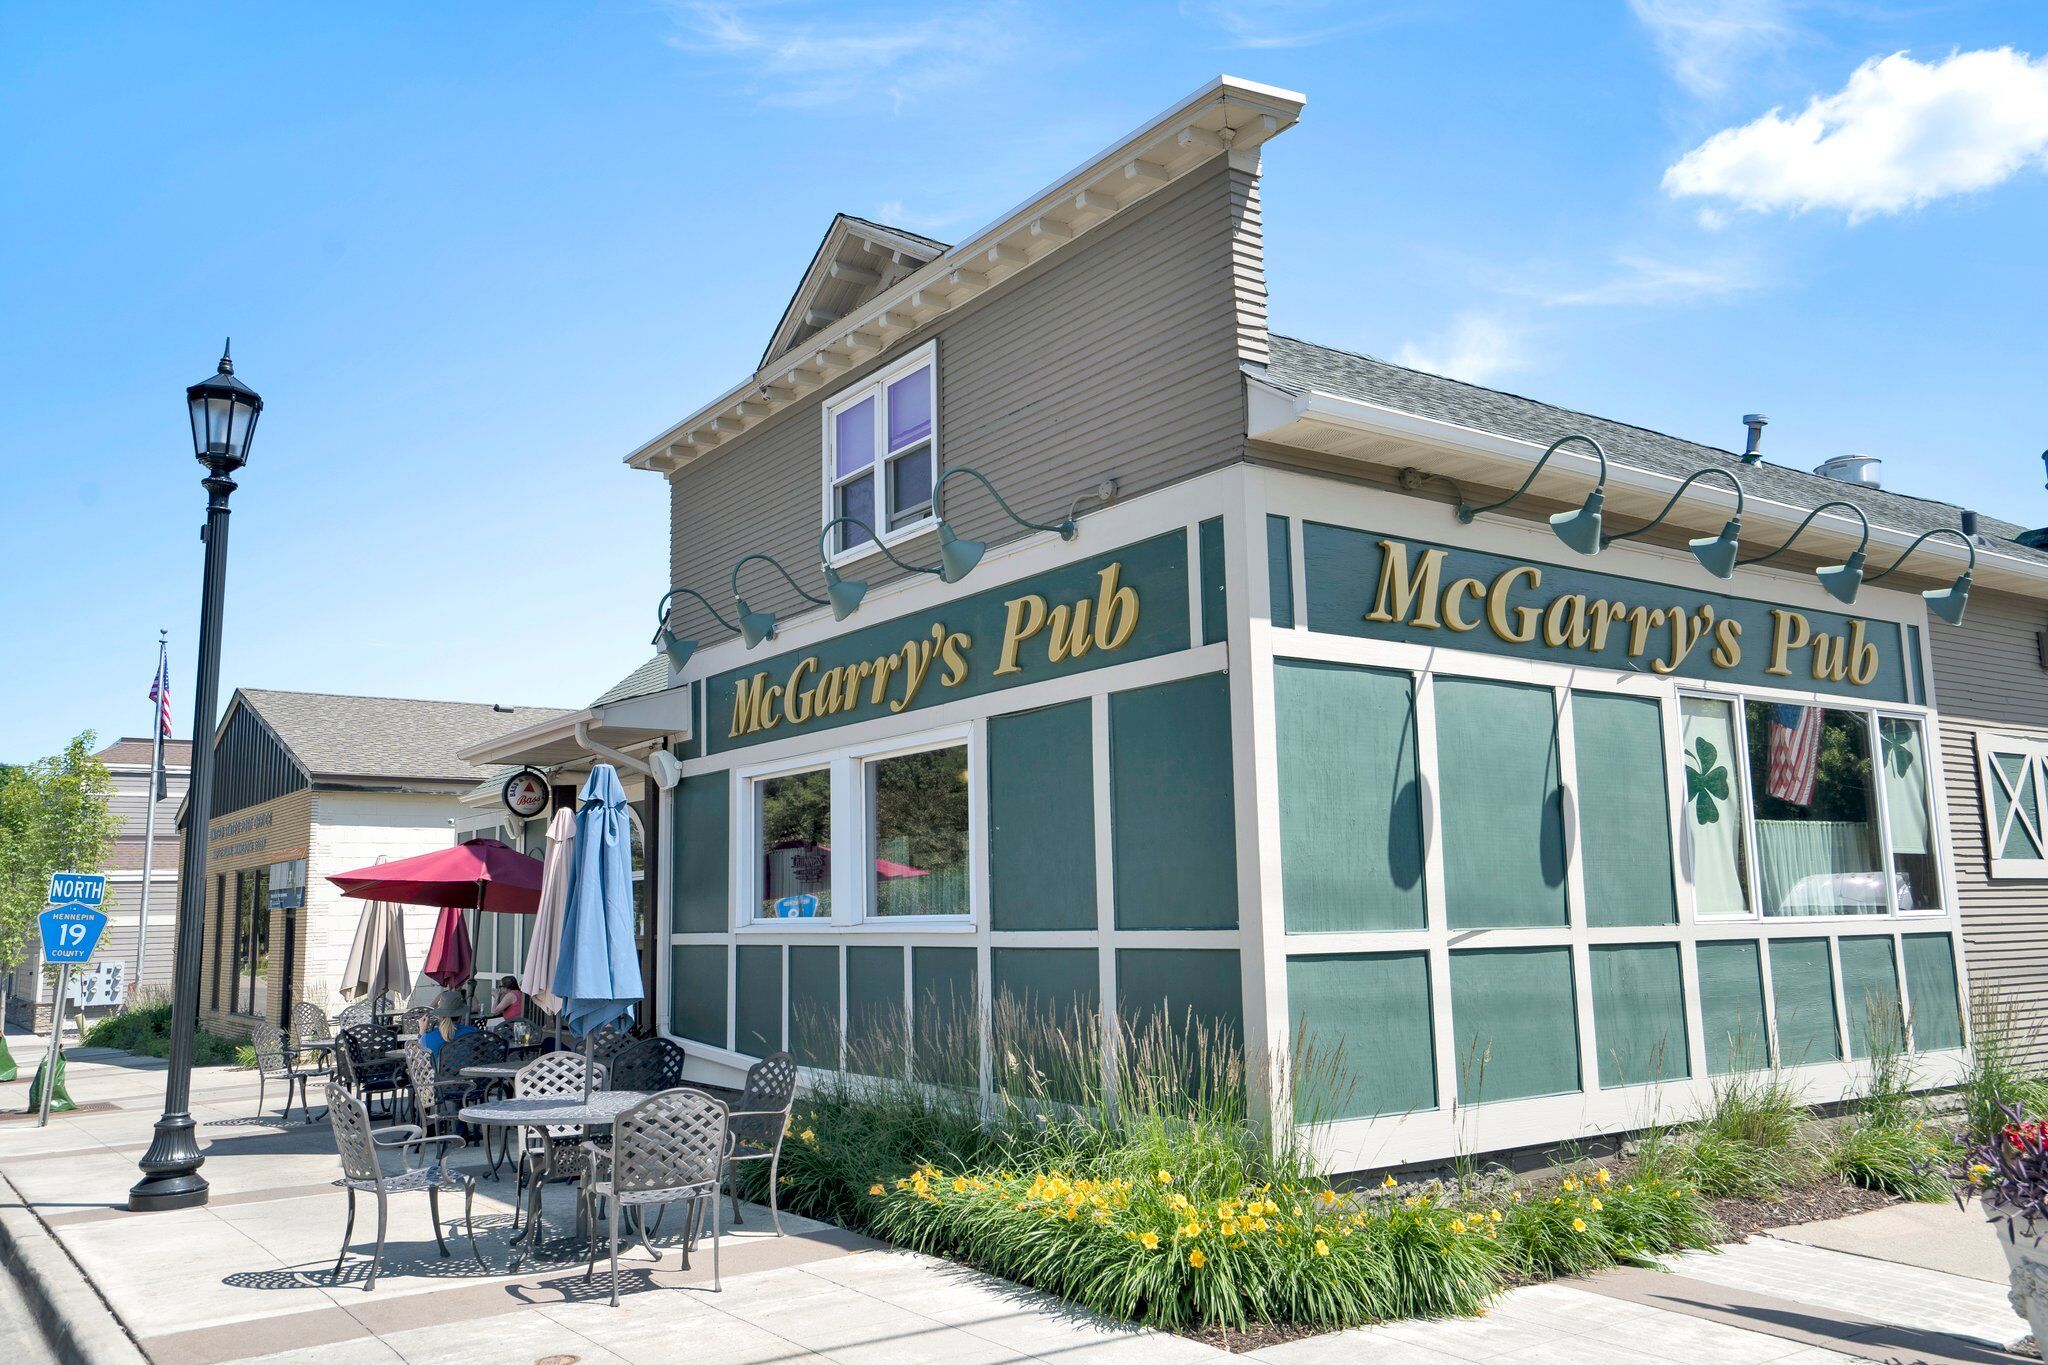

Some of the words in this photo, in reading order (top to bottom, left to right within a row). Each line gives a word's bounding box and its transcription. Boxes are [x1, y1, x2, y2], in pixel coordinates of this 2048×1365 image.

[1364, 539, 1743, 675] McGarry's
[1764, 608, 1880, 686] Pub
[728, 622, 972, 739] McGarry's
[993, 562, 1140, 677] Pub
[516, 794, 541, 806] Bass
[52, 879, 103, 899] NORTH
[52, 913, 95, 921] HENNEPIN
[59, 923, 87, 946] 19
[51, 949, 85, 957] COUNTY
